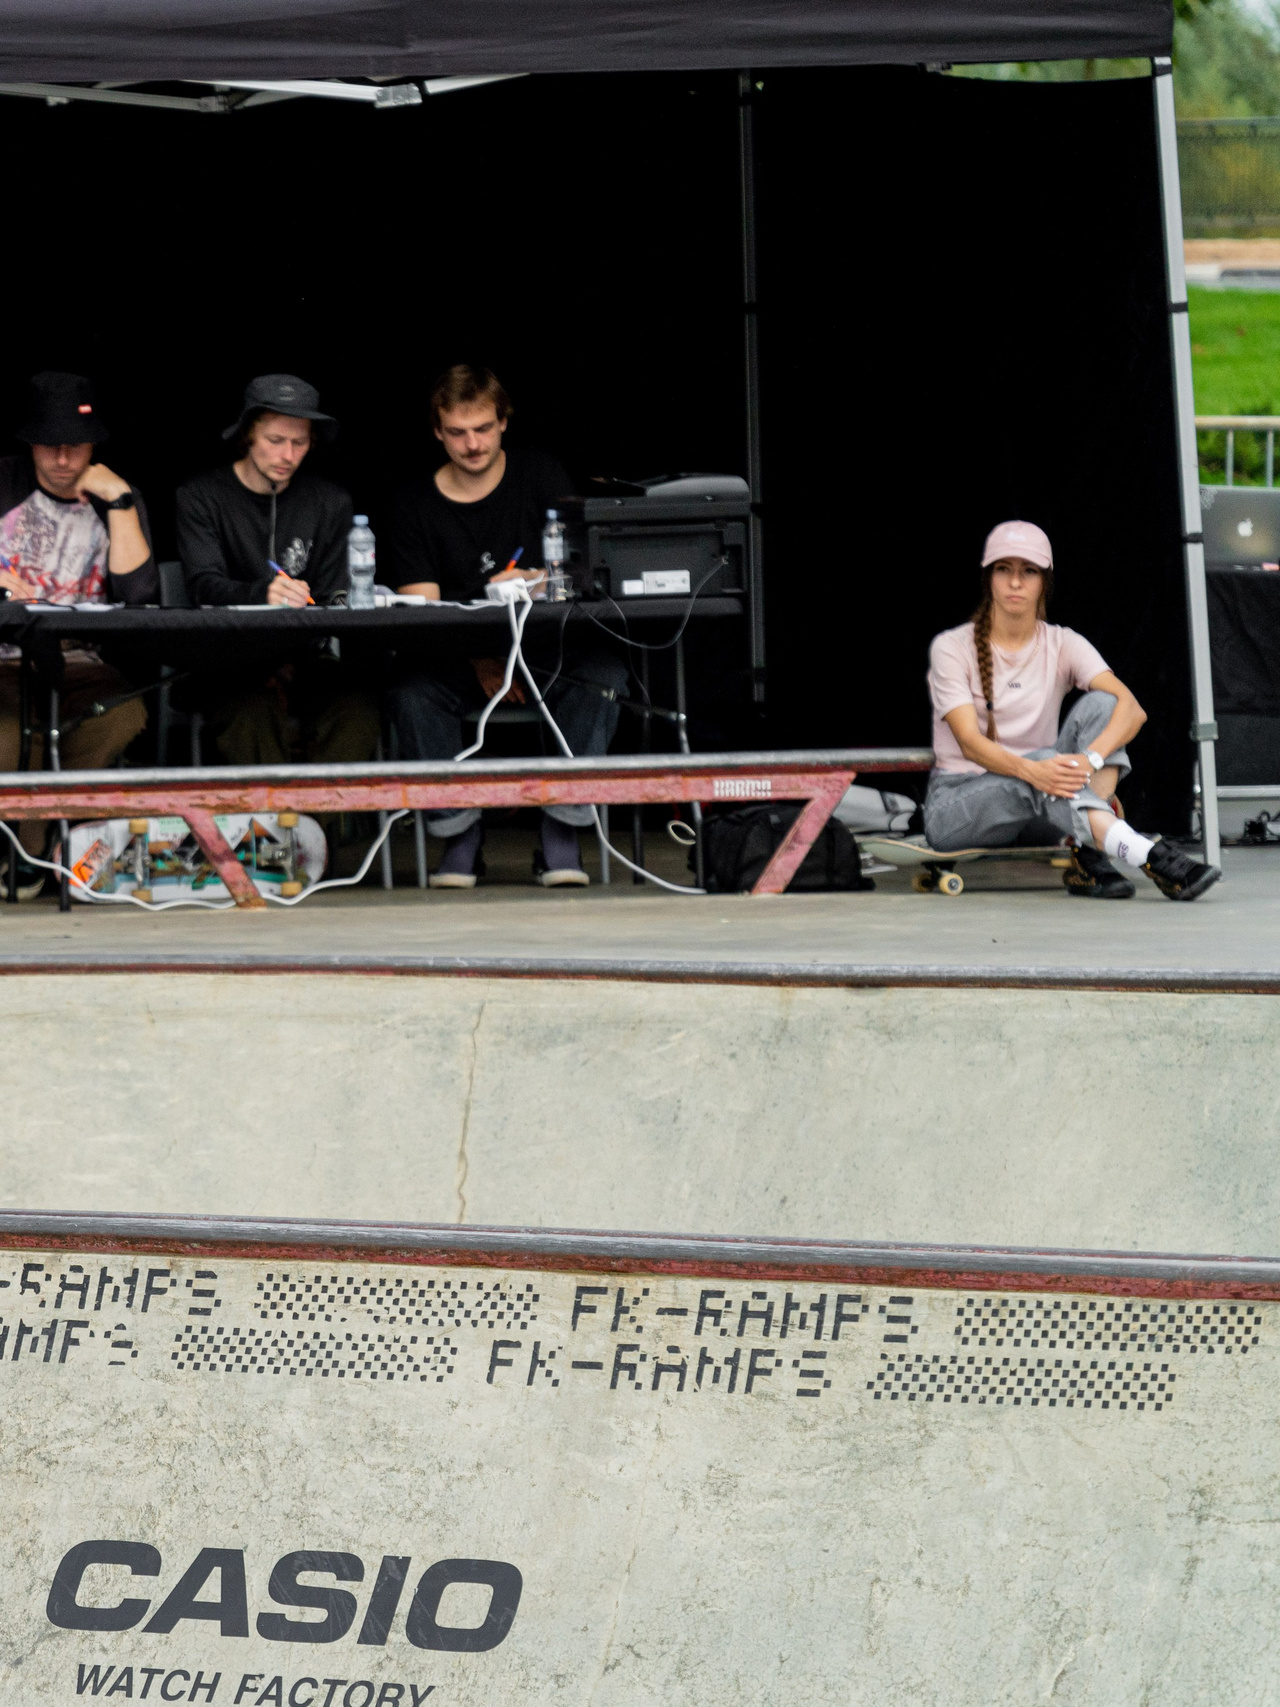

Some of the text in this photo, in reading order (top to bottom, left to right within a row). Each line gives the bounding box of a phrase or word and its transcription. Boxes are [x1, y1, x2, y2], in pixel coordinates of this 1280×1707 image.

[571, 1286, 918, 1343] FK-RAMPS
[487, 1339, 831, 1397] FK-RAMPS
[46, 1540, 523, 1653] CASIO
[76, 1664, 436, 1707] WATCH FACTORY
